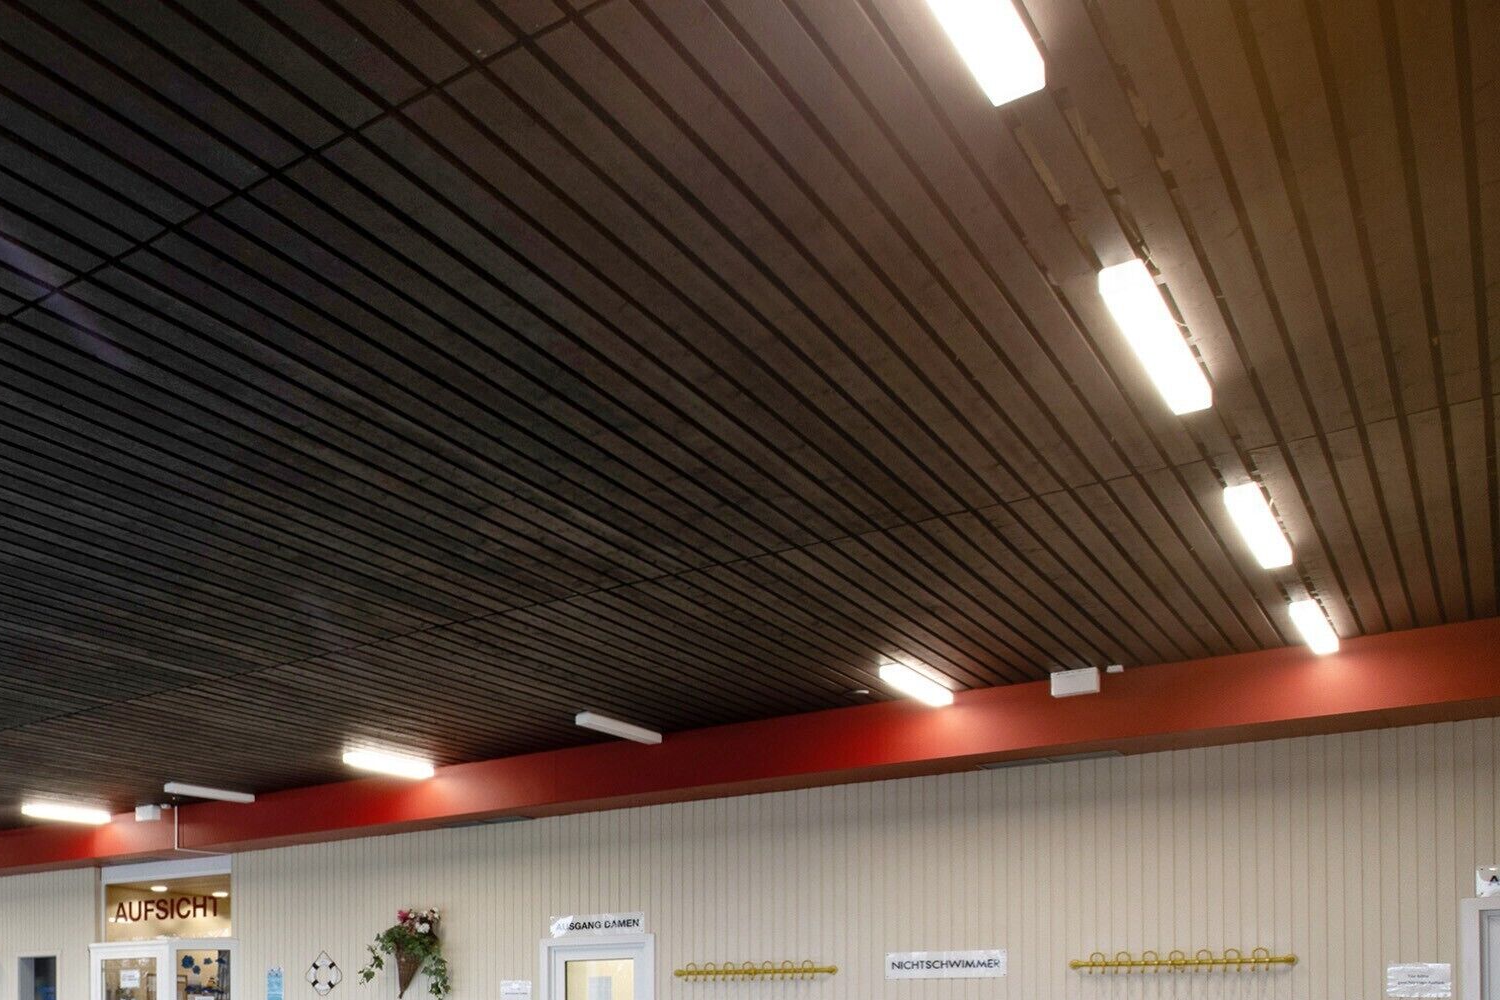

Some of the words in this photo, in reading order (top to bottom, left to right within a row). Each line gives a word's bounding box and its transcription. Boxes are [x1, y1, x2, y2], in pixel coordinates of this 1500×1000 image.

[115, 896, 219, 922] AUFSICHT
[604, 919, 640, 929] DAMEN
[891, 959, 1001, 970] NICHTSCHWIMMER
